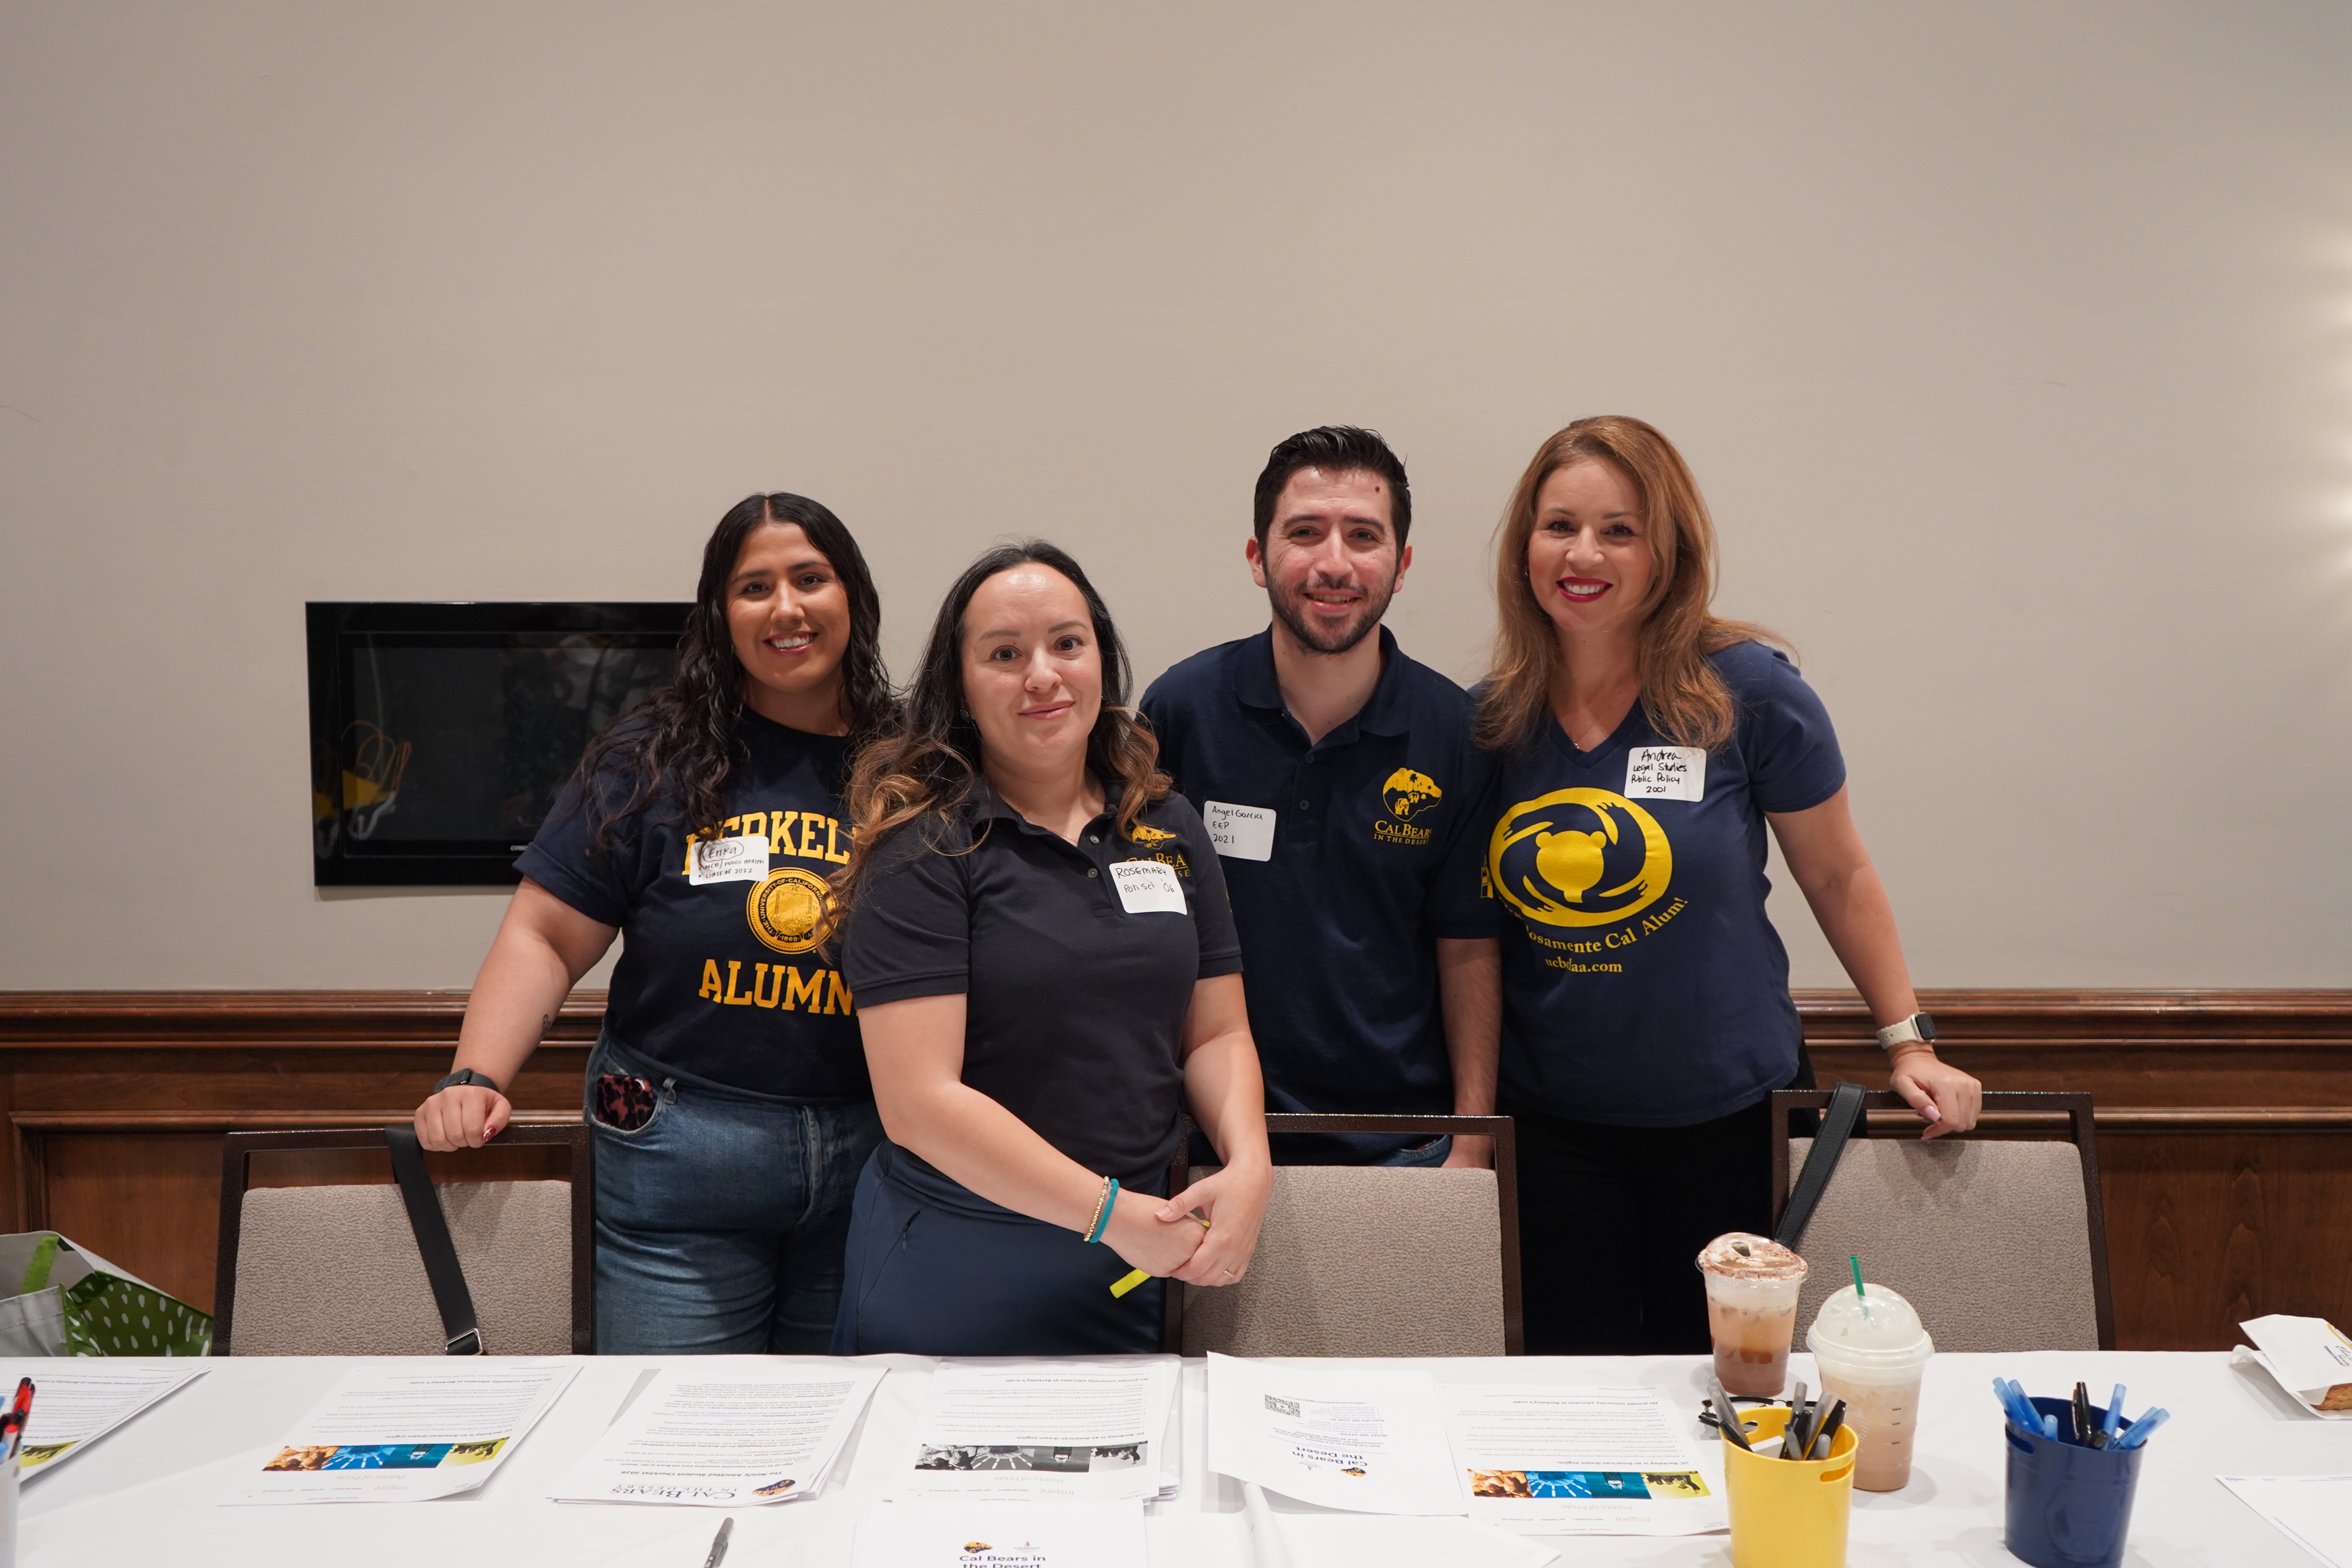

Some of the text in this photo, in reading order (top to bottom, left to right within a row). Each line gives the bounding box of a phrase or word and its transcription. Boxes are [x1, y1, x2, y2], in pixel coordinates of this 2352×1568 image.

[1641, 749, 1682, 762] Andrea
[1633, 762, 1687, 774] Legal Studies
[1657, 772, 1680, 784] Policy
[1212, 806, 1262, 820] Angel Garcia
[1375, 820, 1401, 835] CAL
[1213, 834, 1234, 844] 2021
[1115, 867, 1167, 878] ROSEMARY
[760, 882, 777, 920] UNIVERSITY
[763, 920, 775, 934] THE
[1526, 897, 1688, 953] osamente Cal Alum!
[699, 959, 857, 1016] ALUMN
[1295, 1446, 1337, 1457] Desert
[1308, 1455, 1343, 1464] Bears
[611, 1488, 684, 1498] BEARS
